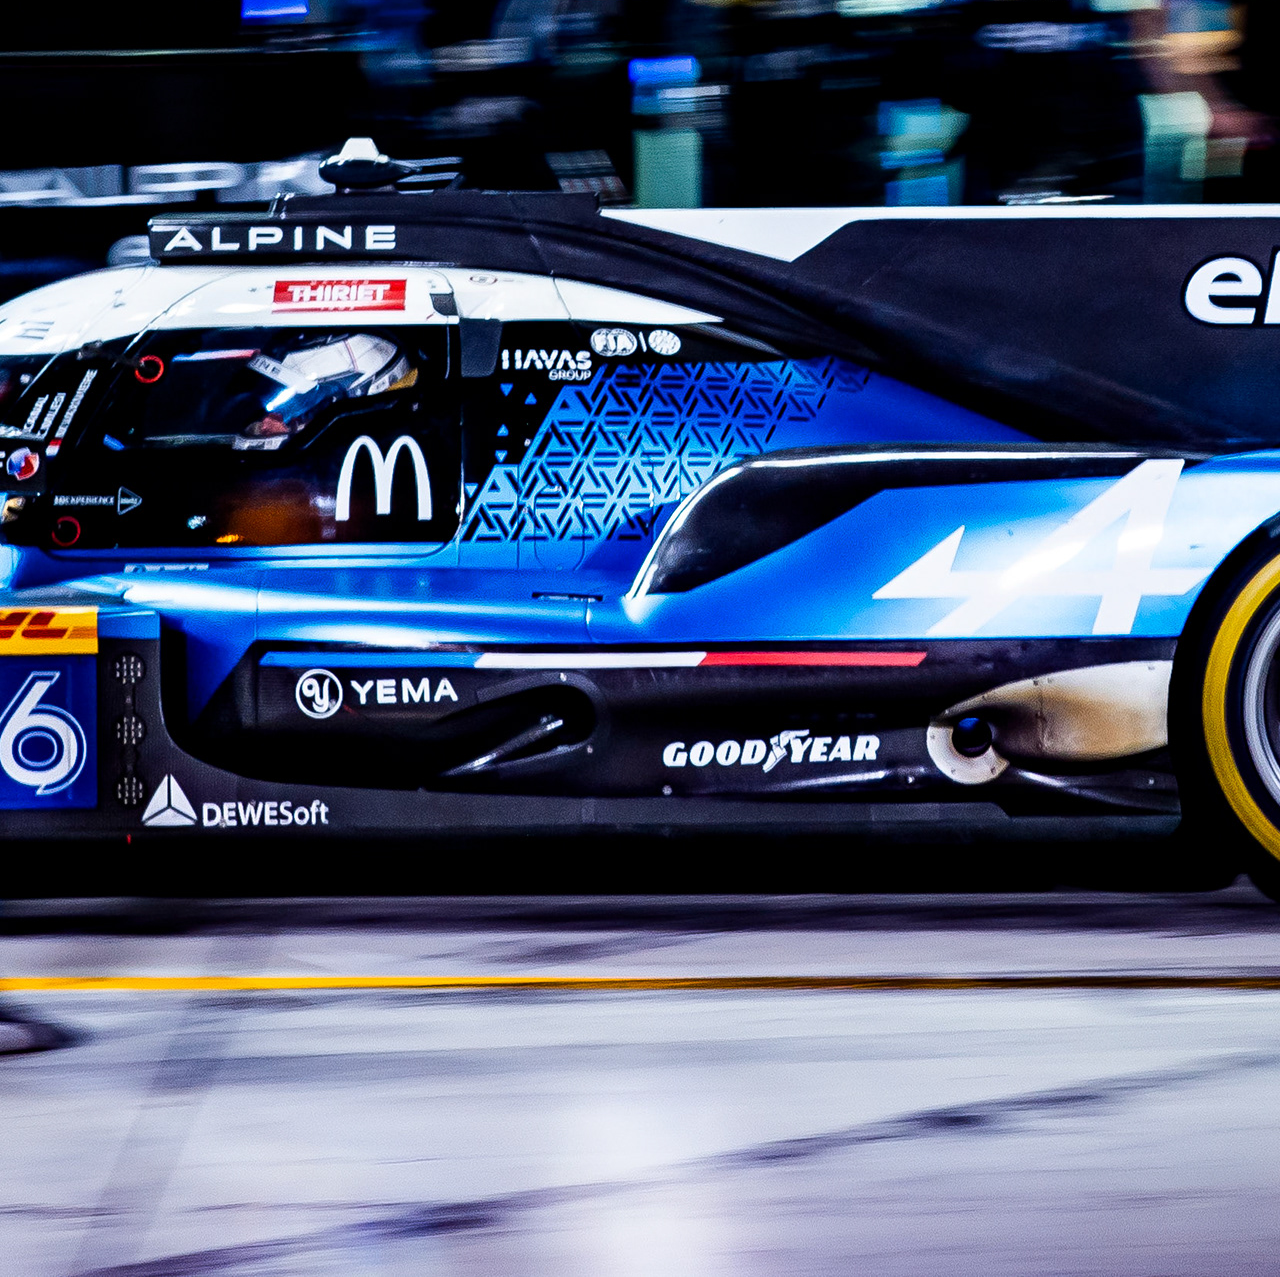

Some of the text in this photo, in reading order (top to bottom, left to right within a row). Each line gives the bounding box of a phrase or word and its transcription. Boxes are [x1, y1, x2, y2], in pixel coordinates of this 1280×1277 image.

[163, 224, 398, 252] ALPINE
[287, 283, 391, 303] THIRIET
[501, 349, 593, 370] HAVAS
[548, 368, 593, 381] GROUP
[350, 677, 459, 705] YEMA
[662, 728, 882, 774] GOODYEAR
[201, 798, 330, 829] DEWESoft
